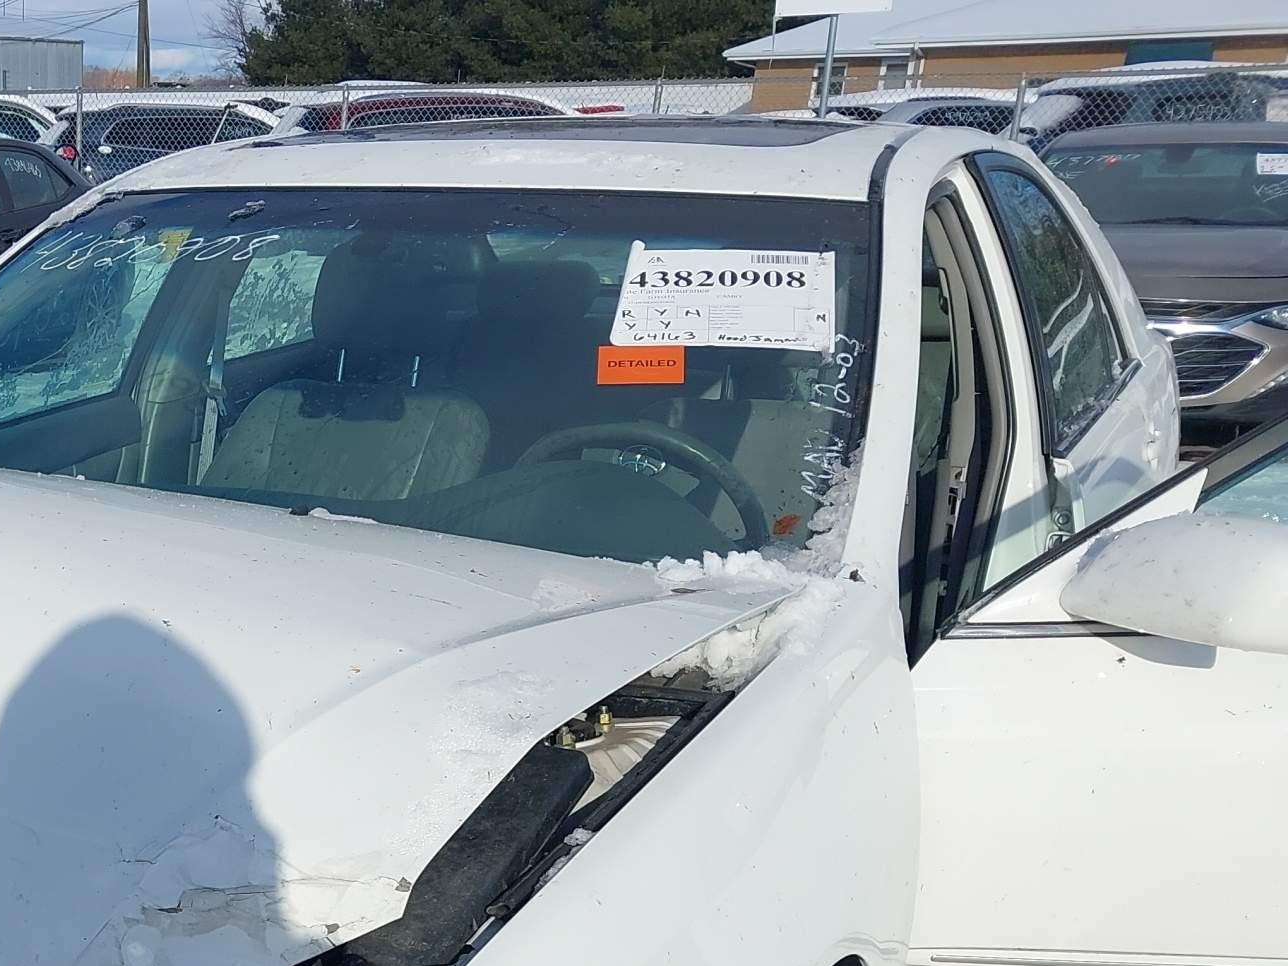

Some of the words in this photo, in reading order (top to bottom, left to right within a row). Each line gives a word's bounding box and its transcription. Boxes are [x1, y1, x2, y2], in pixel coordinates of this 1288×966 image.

[628, 269, 807, 289] 43820908
[622, 309, 636, 319] R
[654, 308, 668, 317] Y
[659, 320, 672, 330] Y
[607, 359, 677, 368] DETAILED
